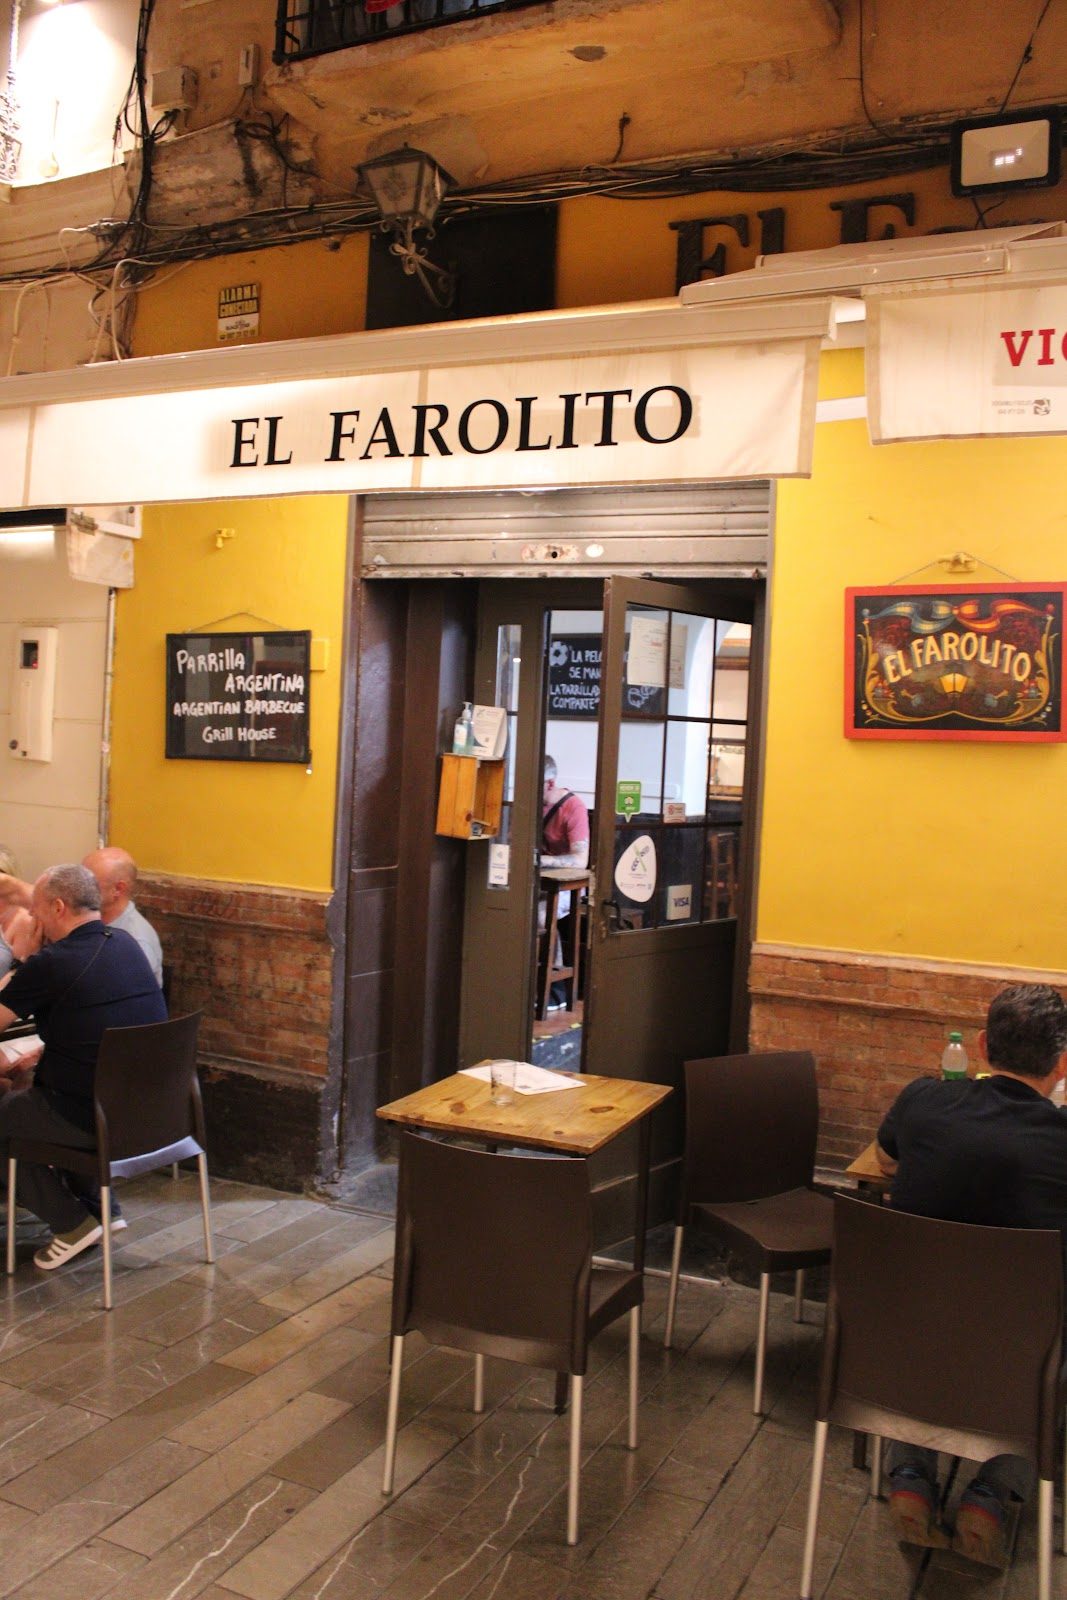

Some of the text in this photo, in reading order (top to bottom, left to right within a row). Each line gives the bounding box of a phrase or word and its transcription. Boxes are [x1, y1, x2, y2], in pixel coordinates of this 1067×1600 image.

[221, 286, 257, 302] ALARMA
[229, 384, 693, 467] EL FAROLITO
[176, 648, 246, 674] PARRillA
[883, 631, 1032, 683] EL FAROLITO
[568, 666, 581, 679] SE
[224, 673, 305, 695] ARGENTiNA
[244, 699, 305, 716] BARBECUE
[202, 726, 277, 743] GRill HOUSE
[673, 898, 690, 907] VISA
